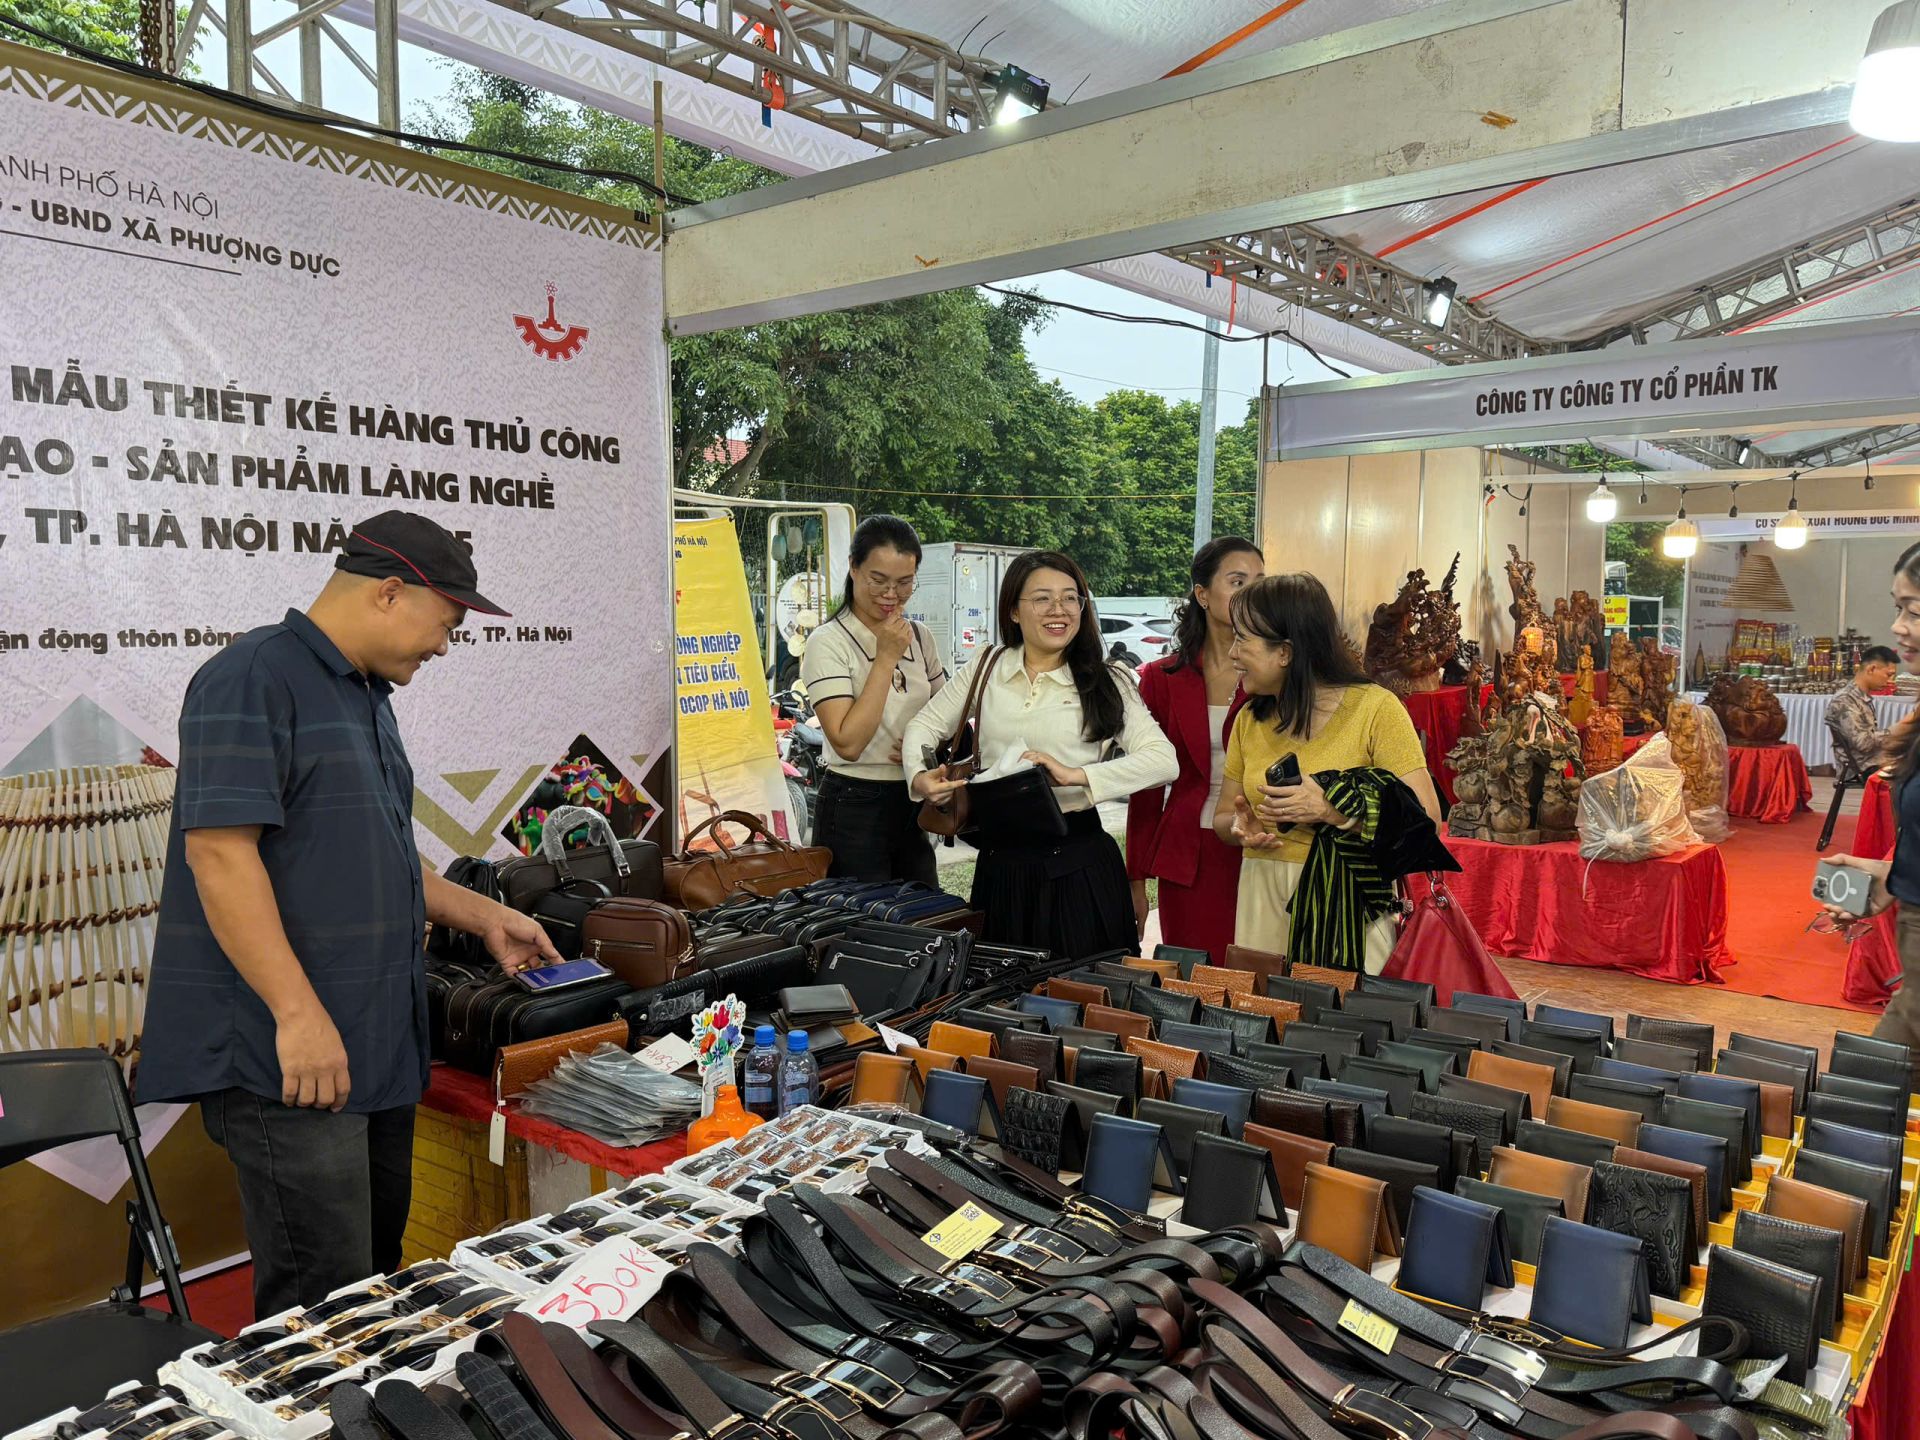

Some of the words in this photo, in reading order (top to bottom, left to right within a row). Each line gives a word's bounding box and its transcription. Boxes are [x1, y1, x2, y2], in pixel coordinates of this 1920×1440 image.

[60, 166, 118, 197] PHỐ
[128, 181, 165, 208] HÀ
[173, 191, 219, 220] NỘI
[31, 199, 111, 233] UBND
[122, 217, 161, 243] XÃ
[171, 227, 282, 265] PHƯỢNG
[290, 250, 341, 279] DỰC
[11, 358, 129, 412] MẪU
[143, 379, 272, 427] THIẾT
[285, 392, 338, 434] KẾ
[350, 404, 454, 446] HÀNG
[464, 416, 530, 454] THỦ
[540, 427, 620, 464] CÔNG
[1476, 388, 1526, 416] CÔNG
[1532, 387, 1555, 411] TY
[1560, 379, 1614, 409] CÔNG
[1620, 378, 1644, 403] TY
[1650, 365, 1680, 401] CỔ
[1684, 362, 1744, 398] PHẦN
[1751, 365, 1779, 392] TK
[126, 438, 219, 486] SẢN
[232, 445, 349, 495] PHẨM
[361, 463, 460, 503] LÀNG
[470, 472, 555, 510] NGHỀ
[24, 507, 100, 546] TP.
[117, 508, 188, 549] HÀ
[201, 512, 279, 557] NỘI
[293, 517, 348, 554] NĂ
[38, 627, 108, 654] động
[117, 628, 178, 648] thôn
[184, 625, 247, 647] Đồn
[449, 628, 477, 646] ực,
[483, 627, 511, 642] TP.
[517, 627, 540, 642] Hà
[545, 626, 573, 644] Nội
[701, 631, 741, 655] NGHIỆP
[684, 662, 709, 684] TIÊU
[711, 657, 740, 682] BIỂU,
[680, 695, 710, 714] OCOP
[712, 689, 728, 711] HÀ
[729, 687, 750, 711] NỘI
